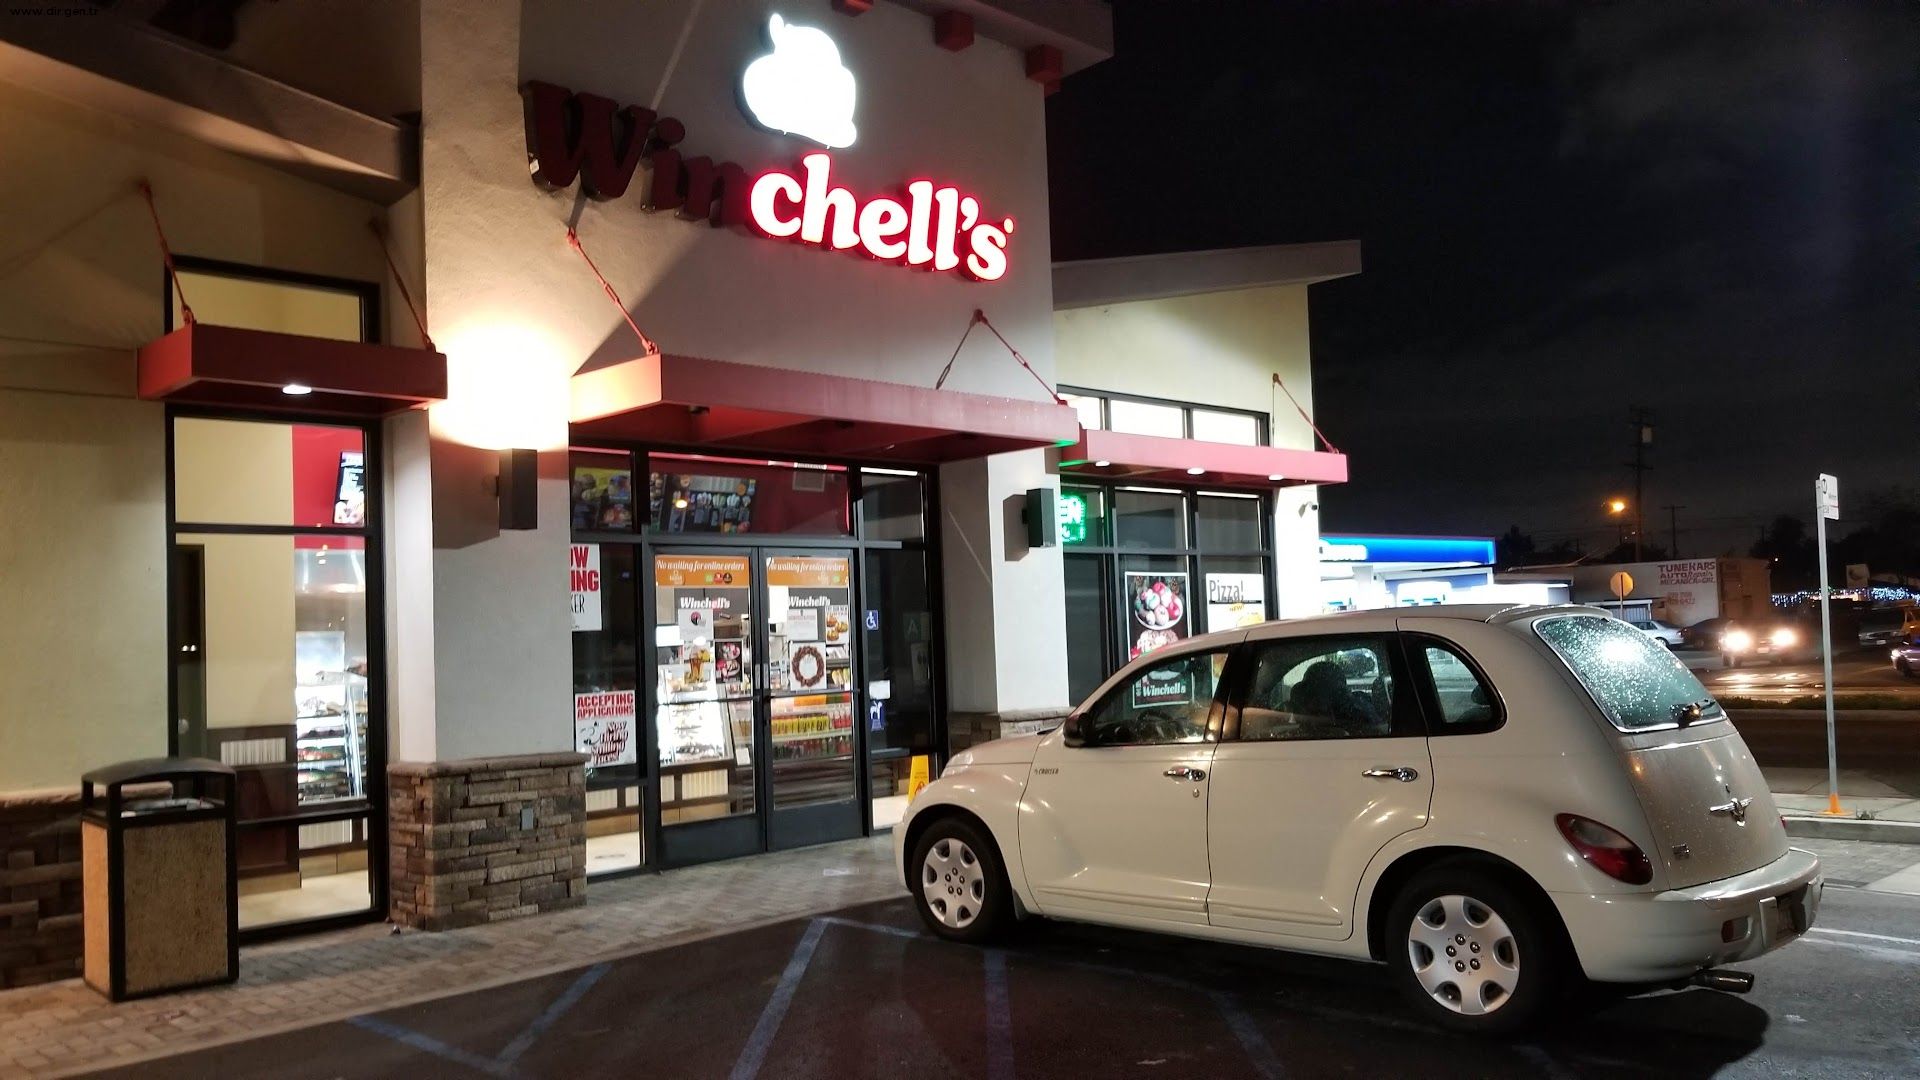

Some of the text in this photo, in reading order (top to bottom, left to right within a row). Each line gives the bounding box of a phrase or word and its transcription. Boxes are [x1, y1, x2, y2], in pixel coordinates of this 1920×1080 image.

[519, 80, 1014, 282] Winchell's
[571, 570, 599, 592] ING
[1209, 579, 1244, 602] Pizza!
[680, 597, 731, 609] Winchell's
[577, 693, 634, 708] ACCEPTING
[577, 705, 634, 719] APPLICATIONS
